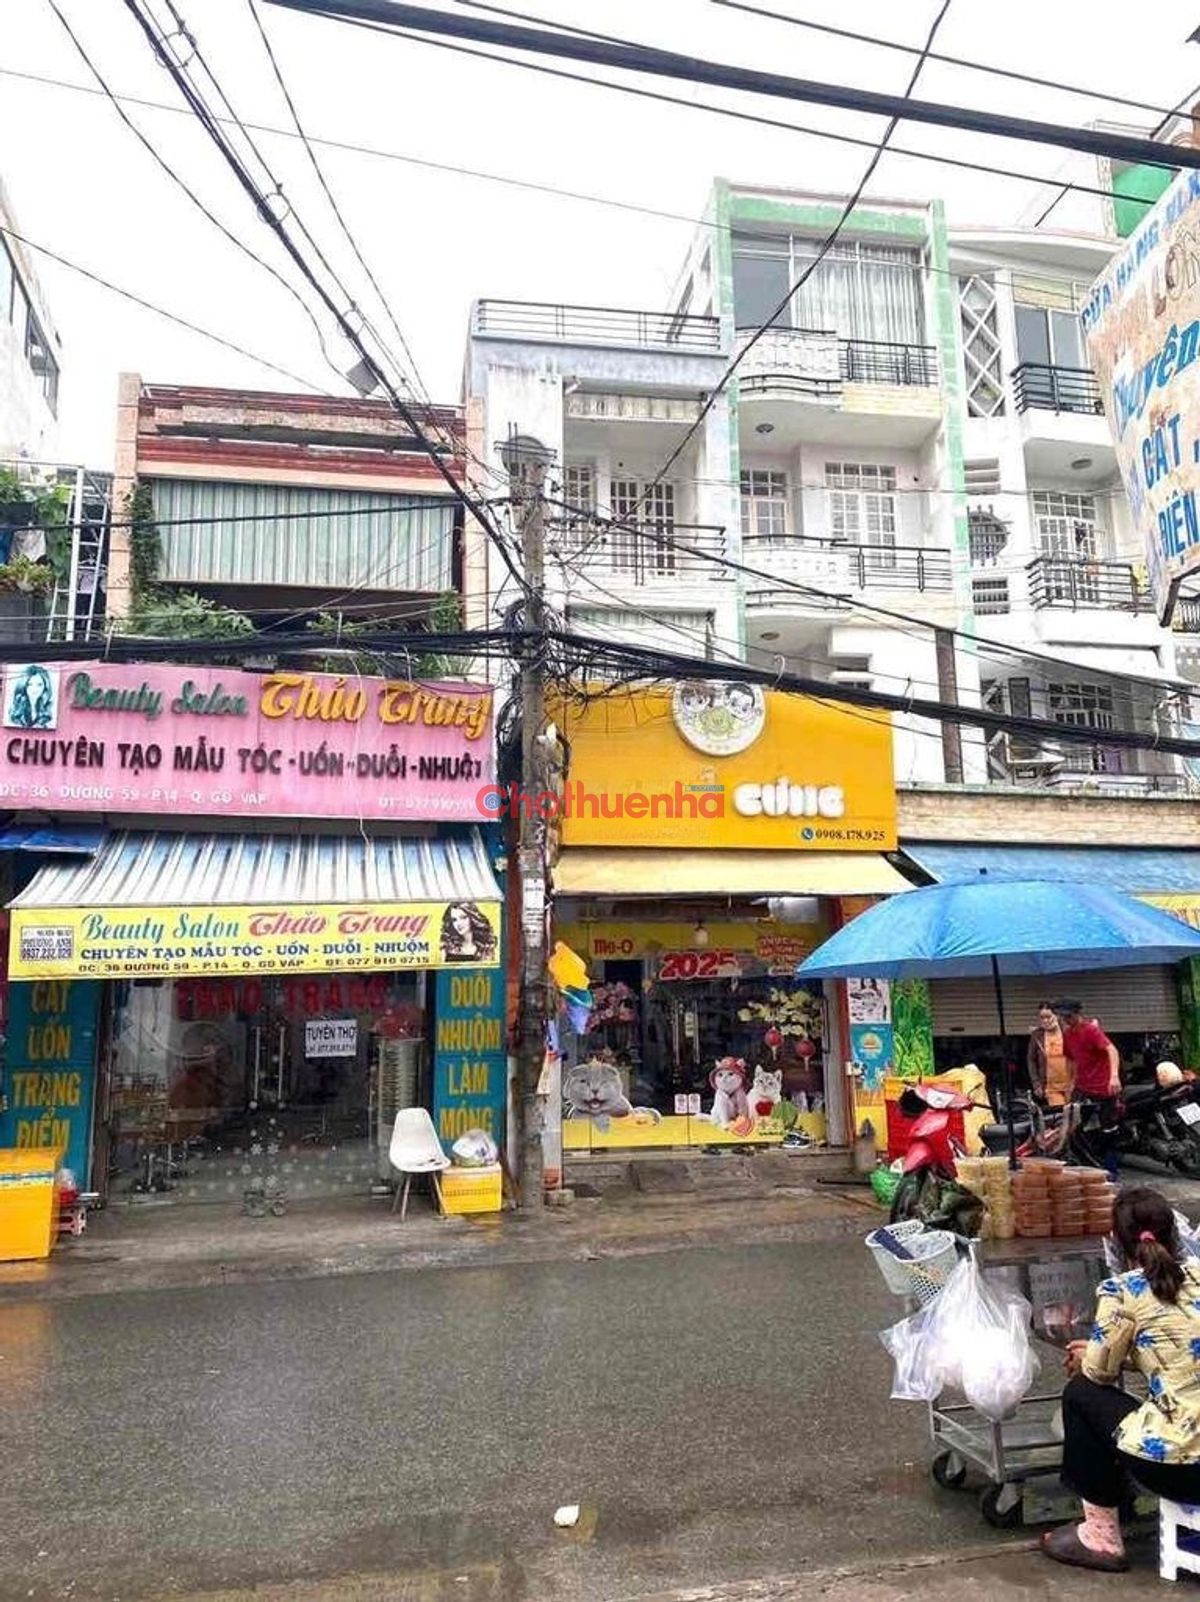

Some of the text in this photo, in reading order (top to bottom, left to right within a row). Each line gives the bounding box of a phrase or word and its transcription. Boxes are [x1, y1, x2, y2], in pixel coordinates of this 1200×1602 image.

[66, 672, 248, 721] Beauty Salon
[378, 682, 492, 741] Trang
[7, 735, 105, 768] CHUYÊN
[118, 743, 162, 776] TẠO
[173, 736, 225, 773] MẪU
[238, 743, 282, 775] TÓC
[815, 828, 885, 841] 0908.178.925
[81, 913, 164, 943] Beauty
[172, 912, 239, 940] Salon
[338, 910, 431, 938] Trang
[80, 945, 148, 961] CHUYÊN
[152, 946, 187, 962] TẠO
[231, 942, 263, 957] TÓC
[374, 938, 430, 955] NHUỘM
[660, 950, 738, 980] 2025
[437, 1012, 501, 1057] NHUỘM
[448, 1057, 489, 1095] LÀM
